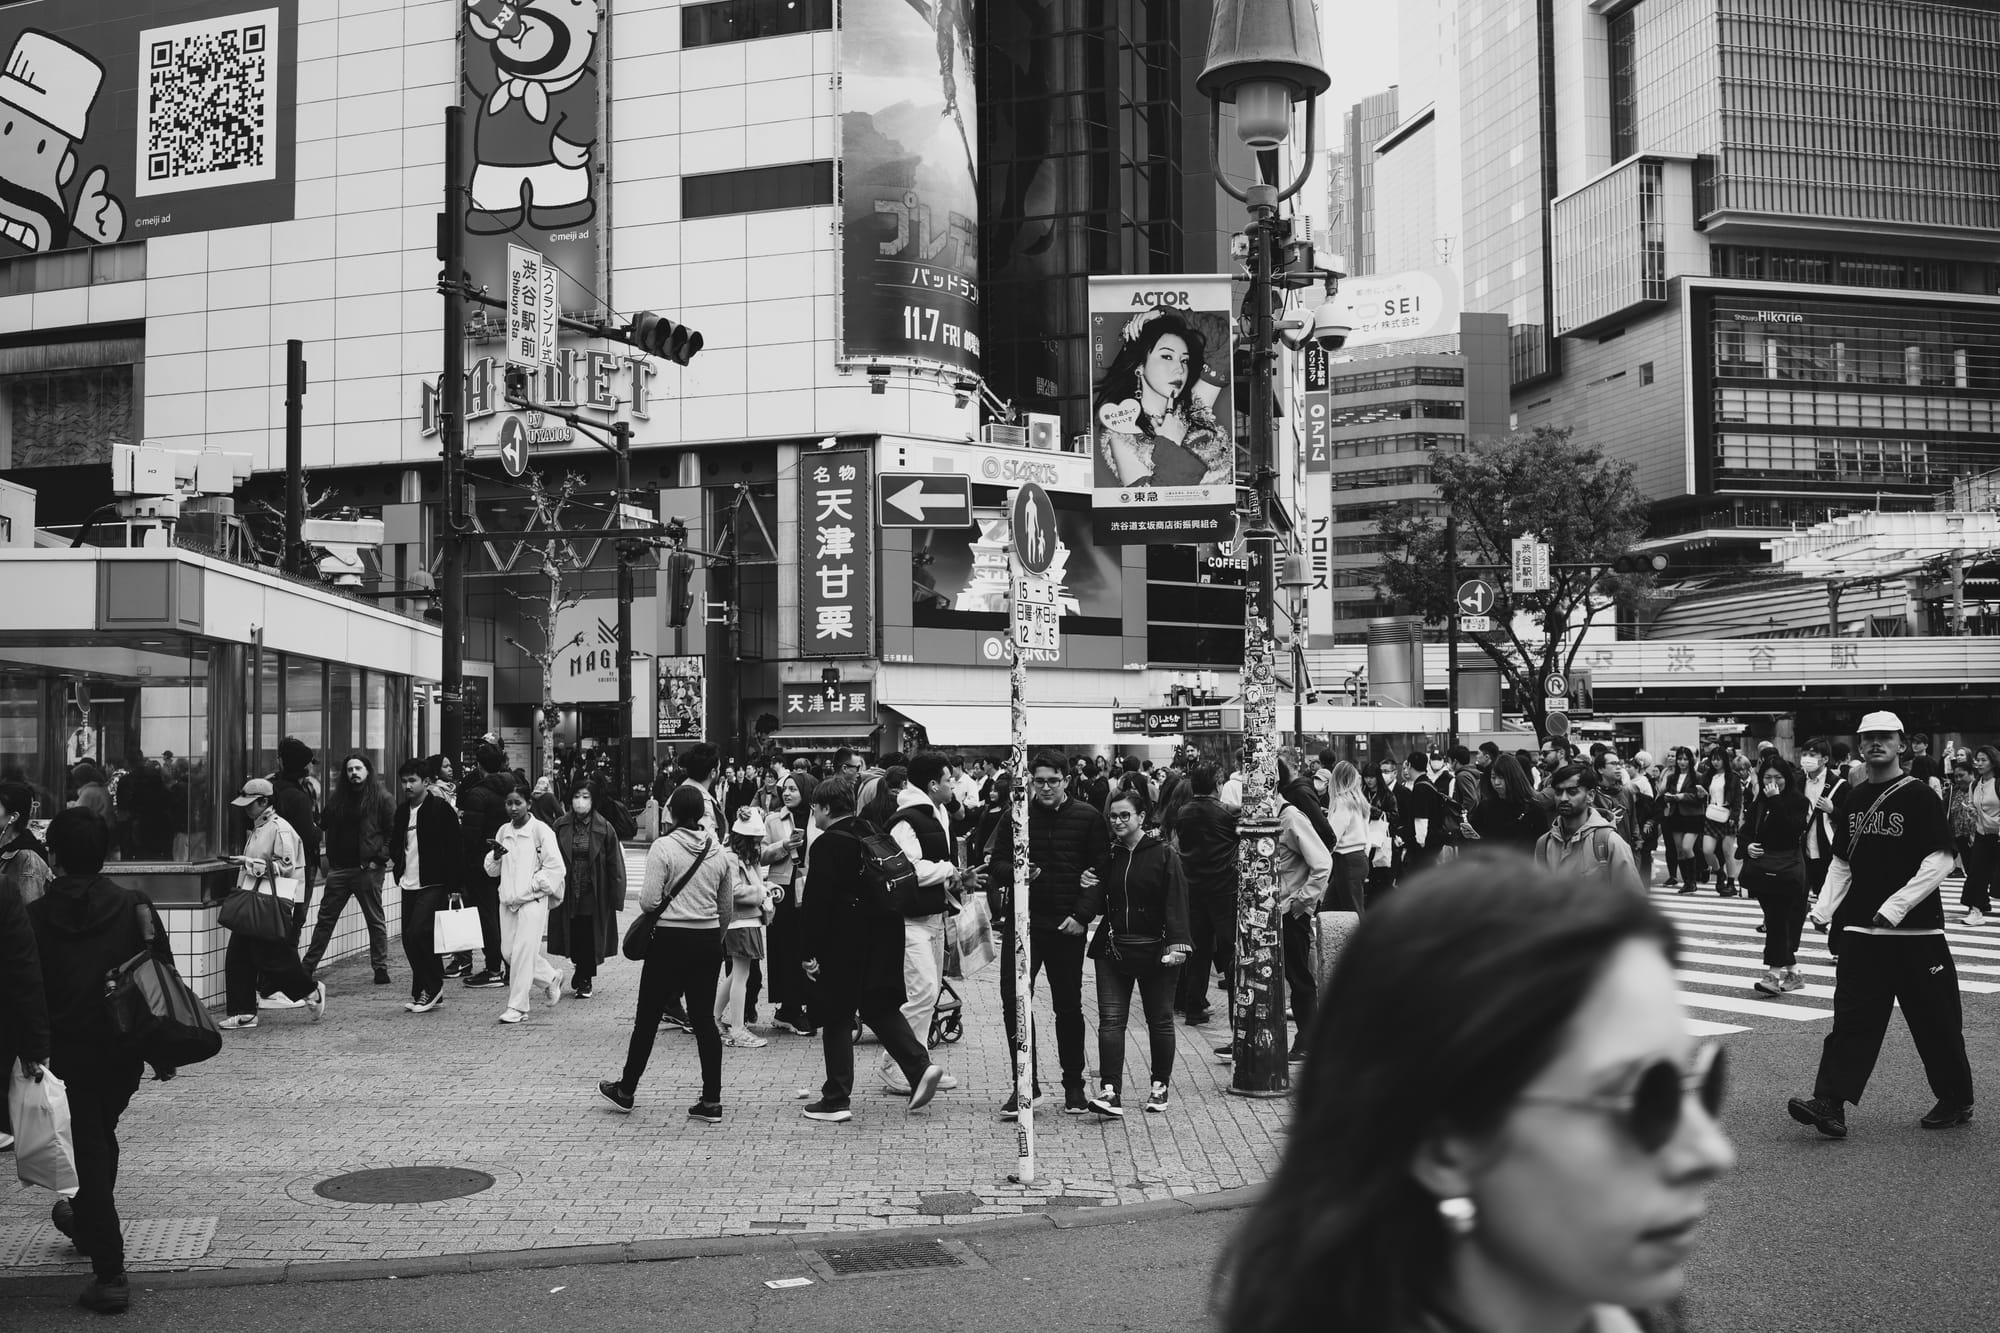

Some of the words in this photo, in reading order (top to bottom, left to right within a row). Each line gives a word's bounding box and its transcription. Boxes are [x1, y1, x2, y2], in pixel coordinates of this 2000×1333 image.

[160, 213, 171, 223] ad
[578, 230, 589, 239] ad
[511, 270, 521, 316] Shibuya
[1131, 291, 1190, 306] ACTOR
[521, 259, 538, 358] 渋谷駅前
[1758, 310, 1803, 323] Hikarie
[511, 319, 520, 341] Sta.
[904, 306, 941, 342] 11.7
[942, 323, 961, 347] FRI
[1308, 350, 1316, 382] クリニック
[526, 411, 543, 427] by
[1311, 420, 1326, 461] アコム
[813, 464, 856, 483] 名物
[1134, 491, 1159, 502] 東急
[1207, 556, 1248, 570] COFFEE
[1311, 516, 1329, 590] プロミス
[815, 488, 855, 640] 天津甘栗
[1522, 543, 1533, 588] 渋谷駅前
[1019, 582, 1028, 600] 15
[1047, 586, 1054, 602] 5
[1020, 625, 1029, 643] 12
[787, 693, 867, 713] 天津甘栗
